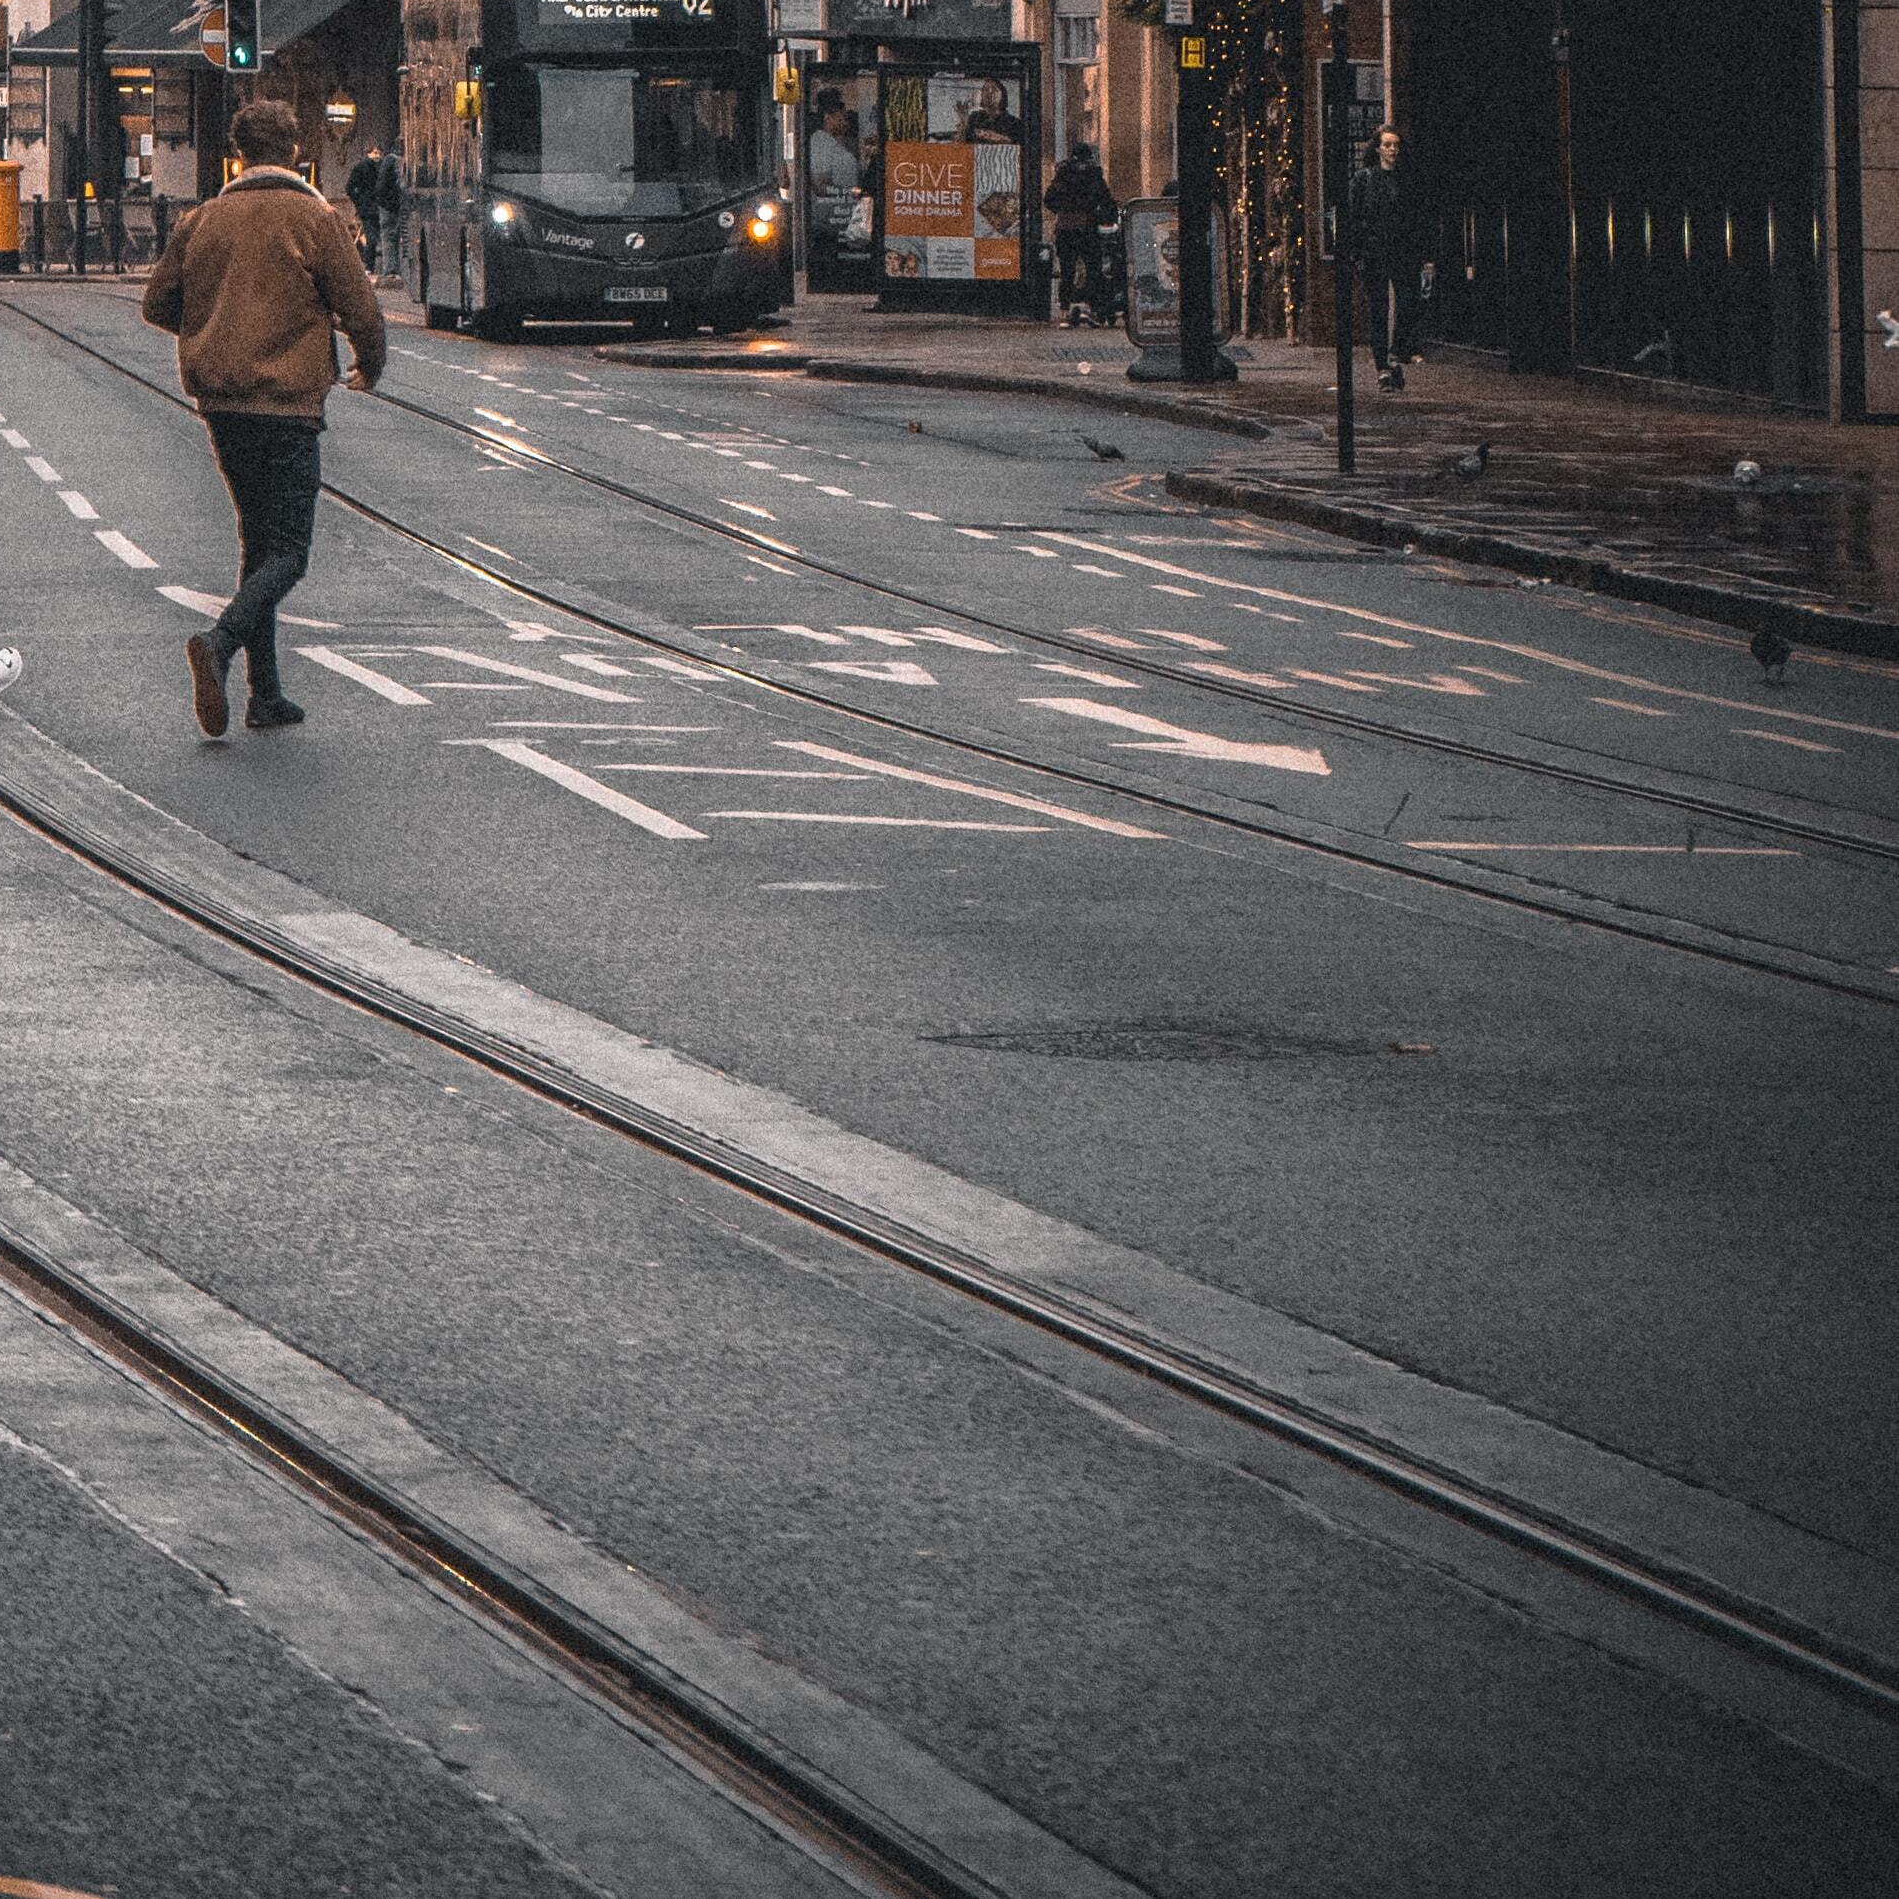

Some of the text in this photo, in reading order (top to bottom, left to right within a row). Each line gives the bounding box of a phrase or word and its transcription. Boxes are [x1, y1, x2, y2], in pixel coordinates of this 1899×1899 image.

[585, 4, 613, 18] City
[615, 4, 660, 18] Centre
[893, 161, 964, 189] GIVE
[893, 188, 964, 206] DINNER
[893, 205, 964, 218] SOME DRAMA
[541, 227, 596, 251] Vantage
